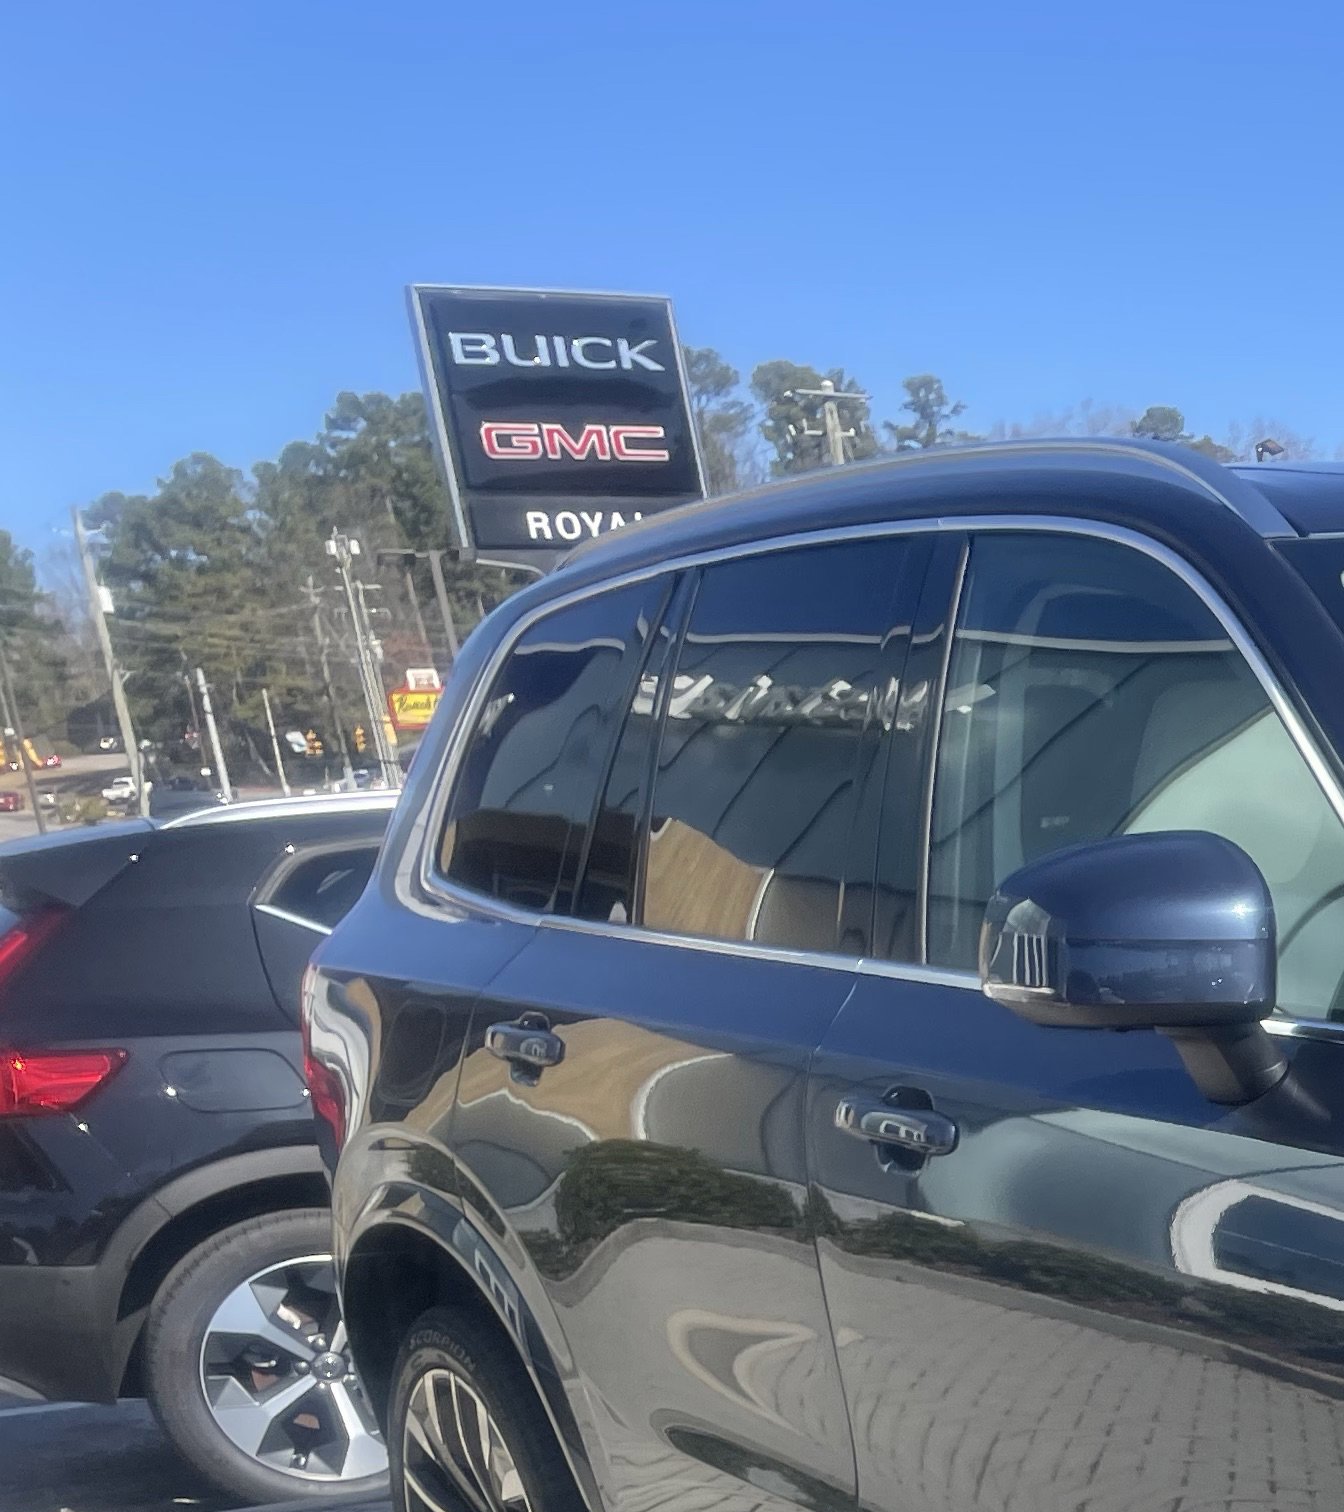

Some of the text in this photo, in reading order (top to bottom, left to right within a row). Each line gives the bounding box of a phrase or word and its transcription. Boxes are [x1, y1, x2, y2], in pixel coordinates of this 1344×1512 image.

[449, 332, 666, 371] BUICK
[480, 421, 669, 461] GMC
[526, 511, 642, 540] ROYA
